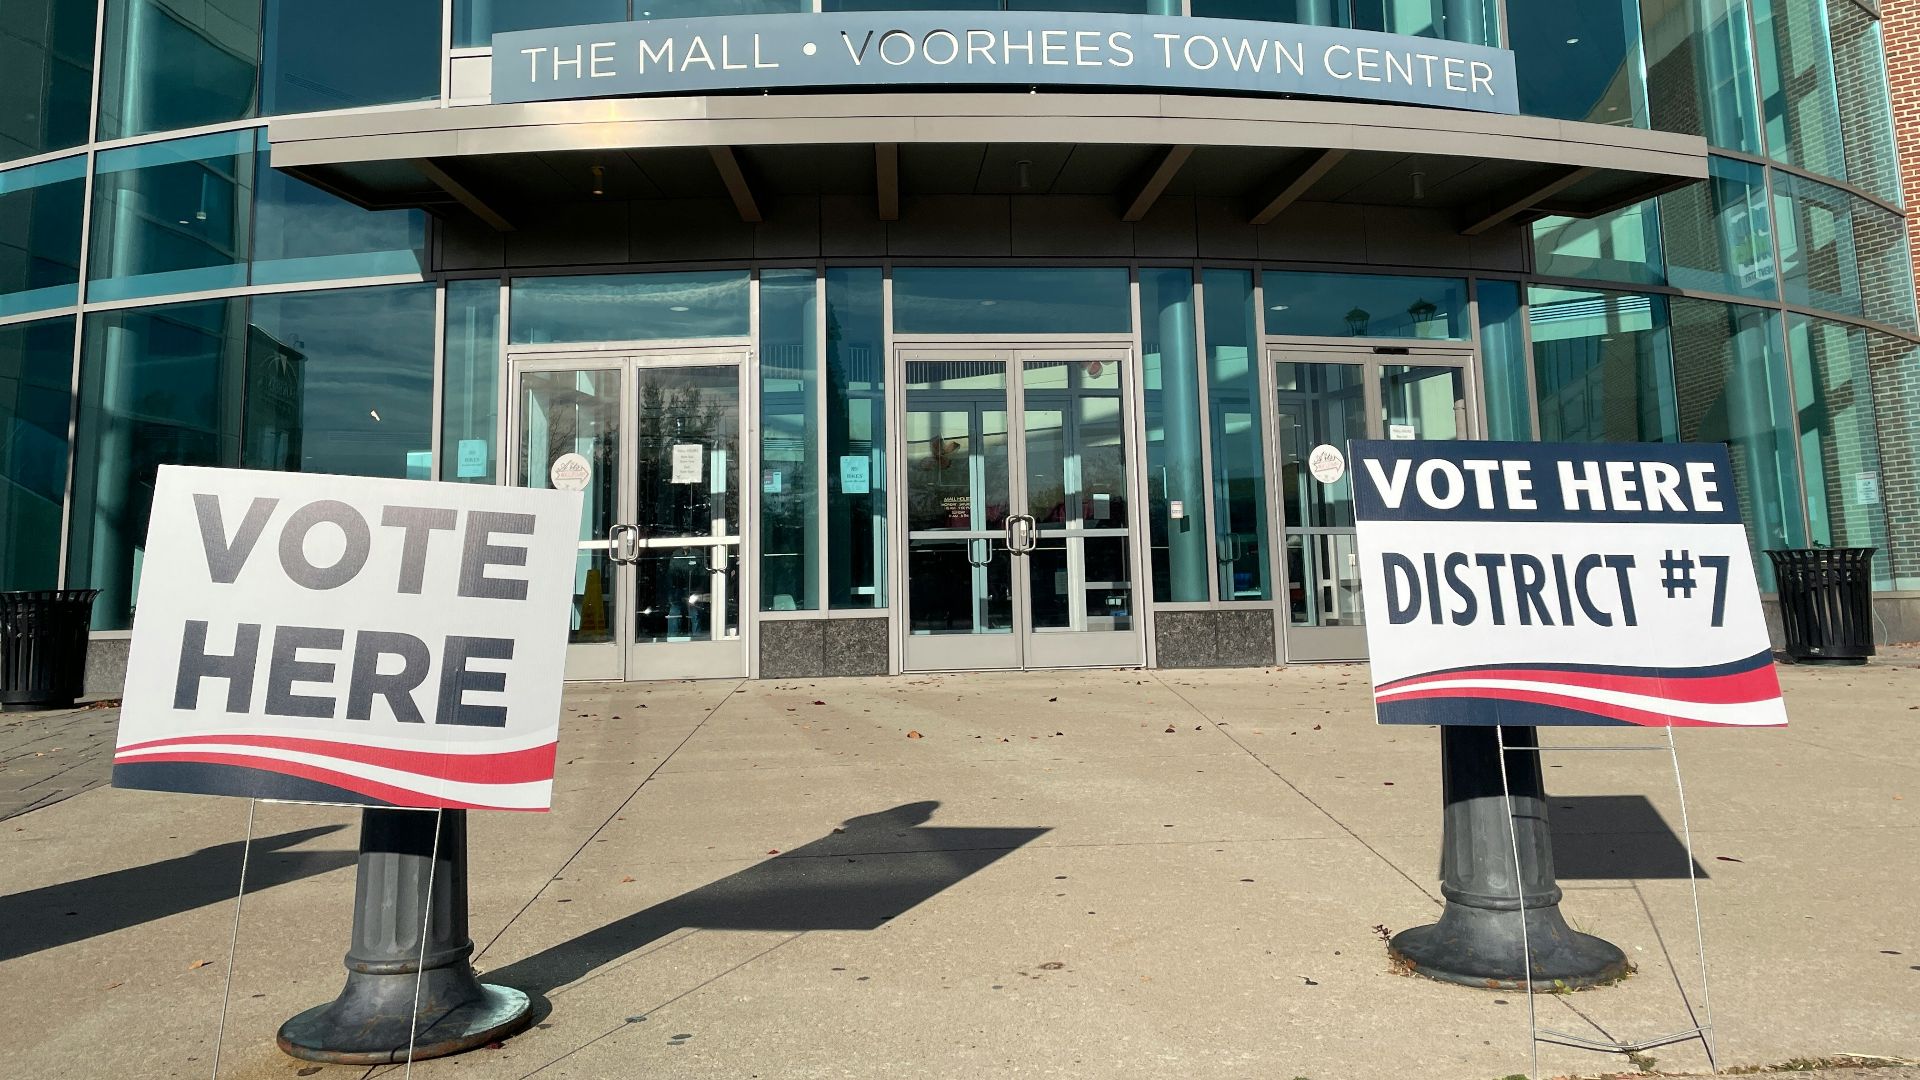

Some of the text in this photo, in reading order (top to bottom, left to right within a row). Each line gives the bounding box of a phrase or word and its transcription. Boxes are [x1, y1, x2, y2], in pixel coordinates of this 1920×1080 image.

[521, 29, 1496, 97] THE MALL VOORHEES TOWN CENTER
[1363, 458, 1724, 512] VOTE HERE
[193, 494, 536, 600] VOTE
[1382, 549, 1730, 627] DISTRICT #7
[173, 619, 515, 728] HERE
